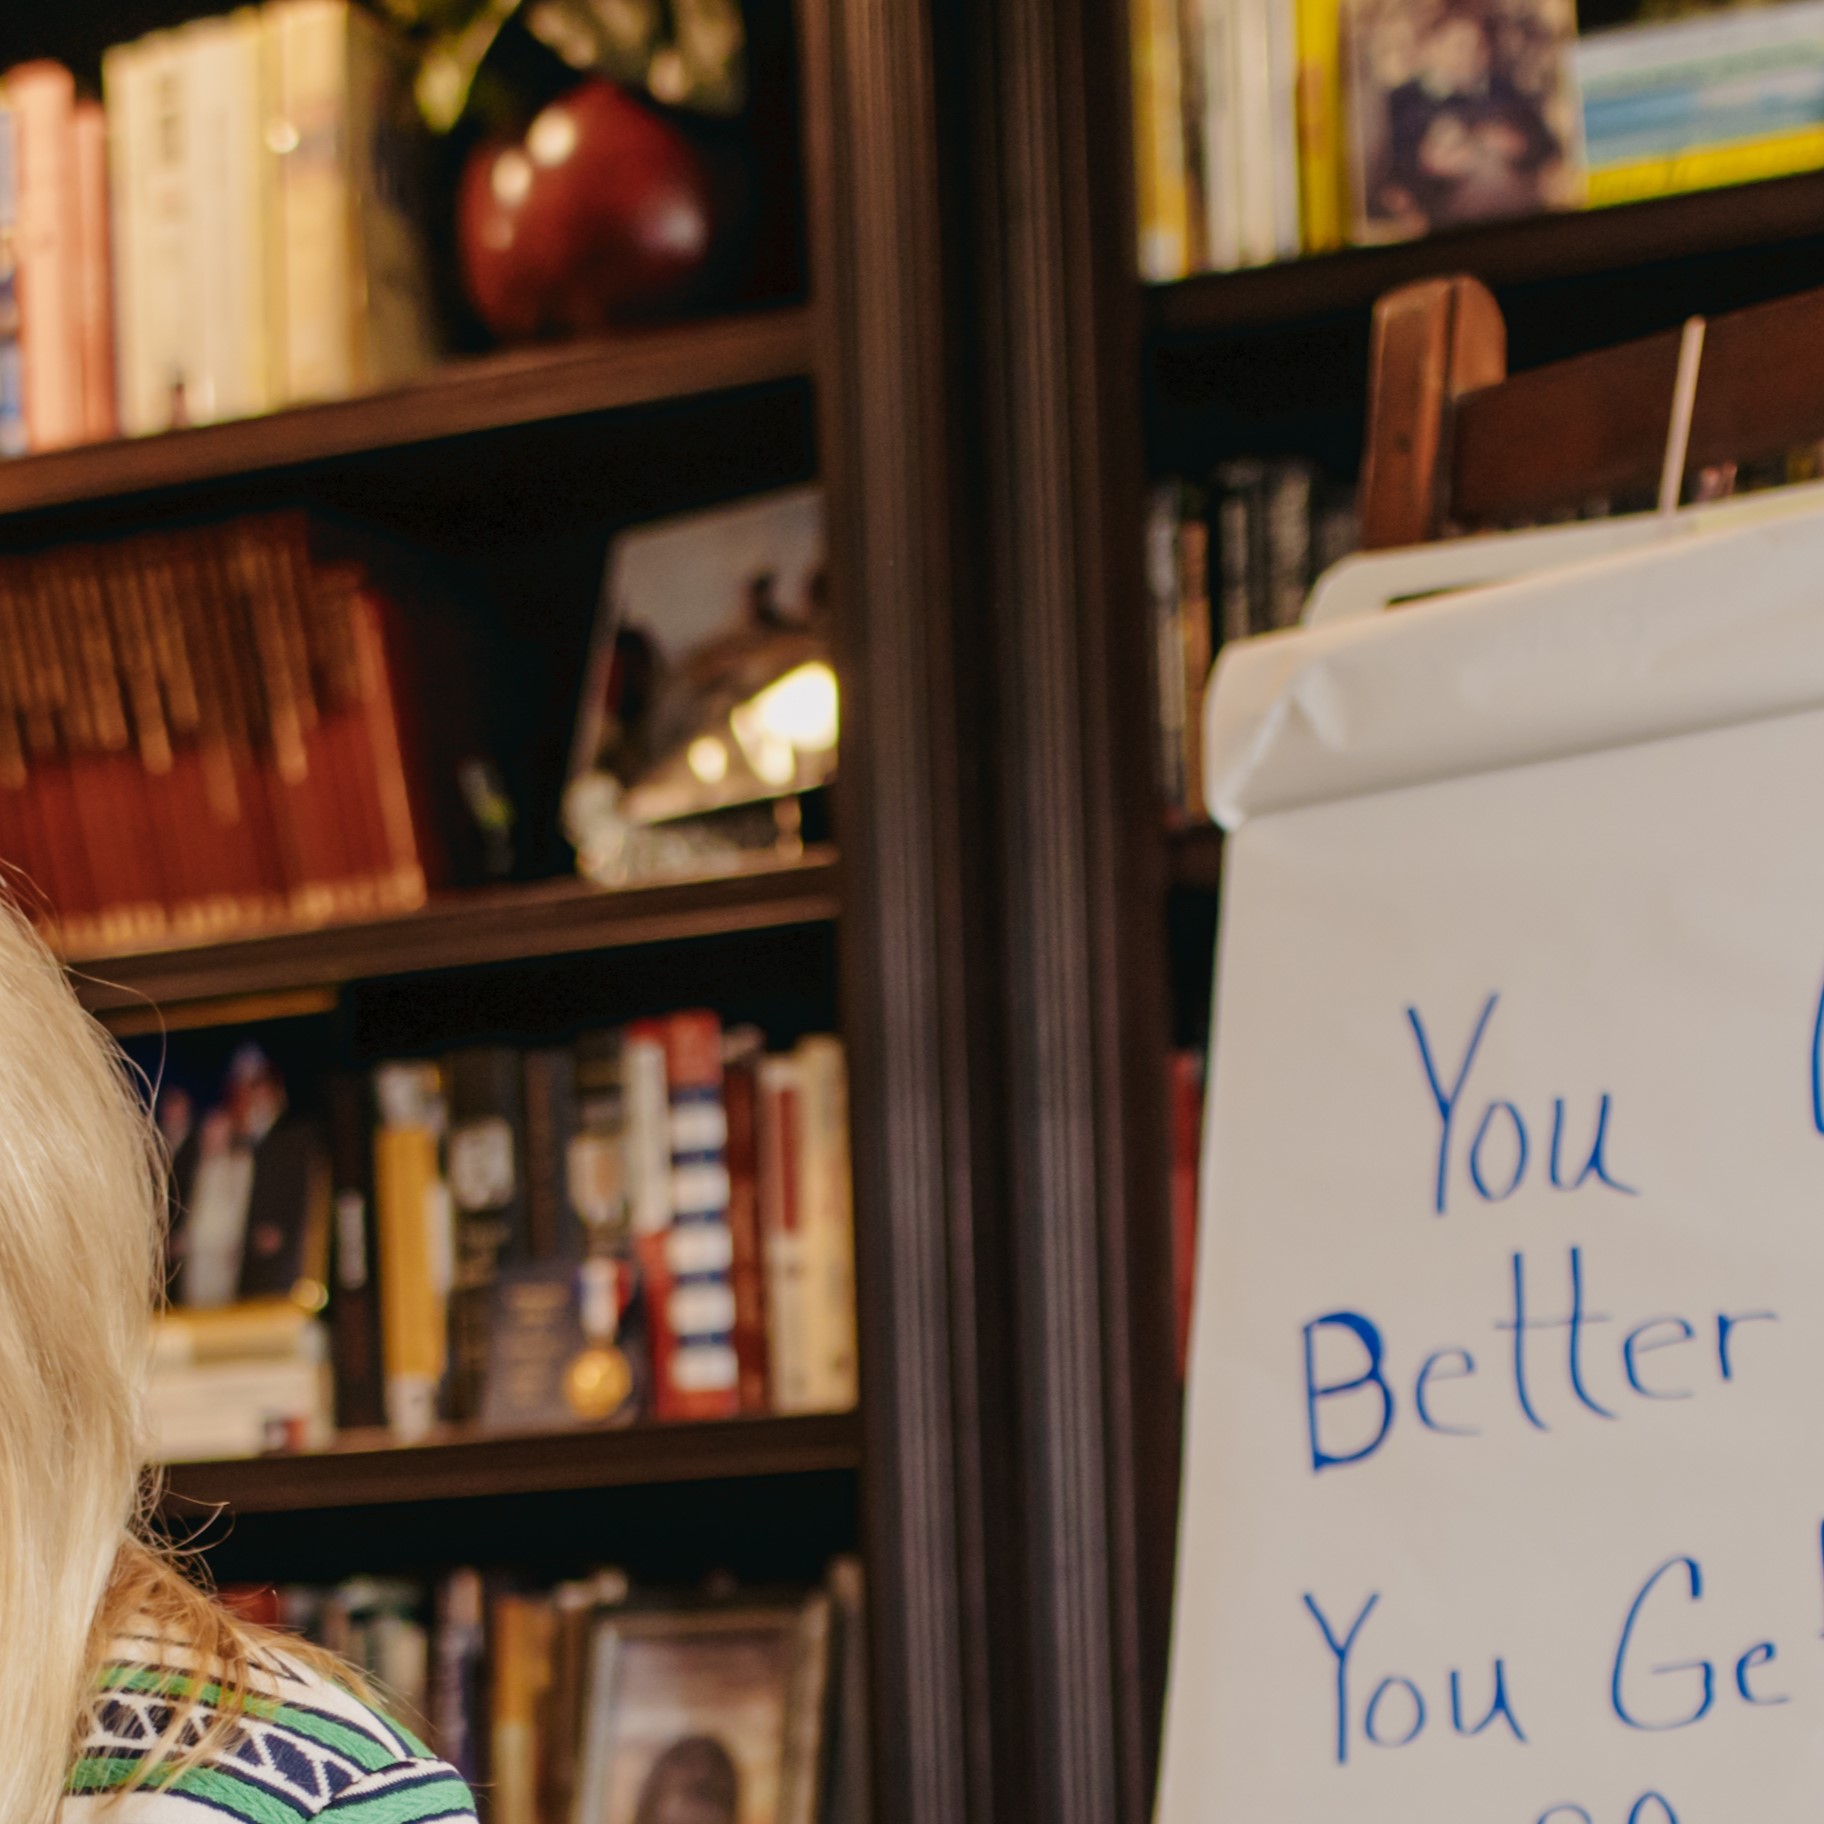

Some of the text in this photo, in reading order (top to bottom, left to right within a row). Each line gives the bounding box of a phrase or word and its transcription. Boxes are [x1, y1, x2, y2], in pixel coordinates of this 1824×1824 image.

[1404, 992, 1639, 1216] You
[1301, 1245, 1779, 1476] Better
[1301, 1517, 1824, 1766] You Ge
